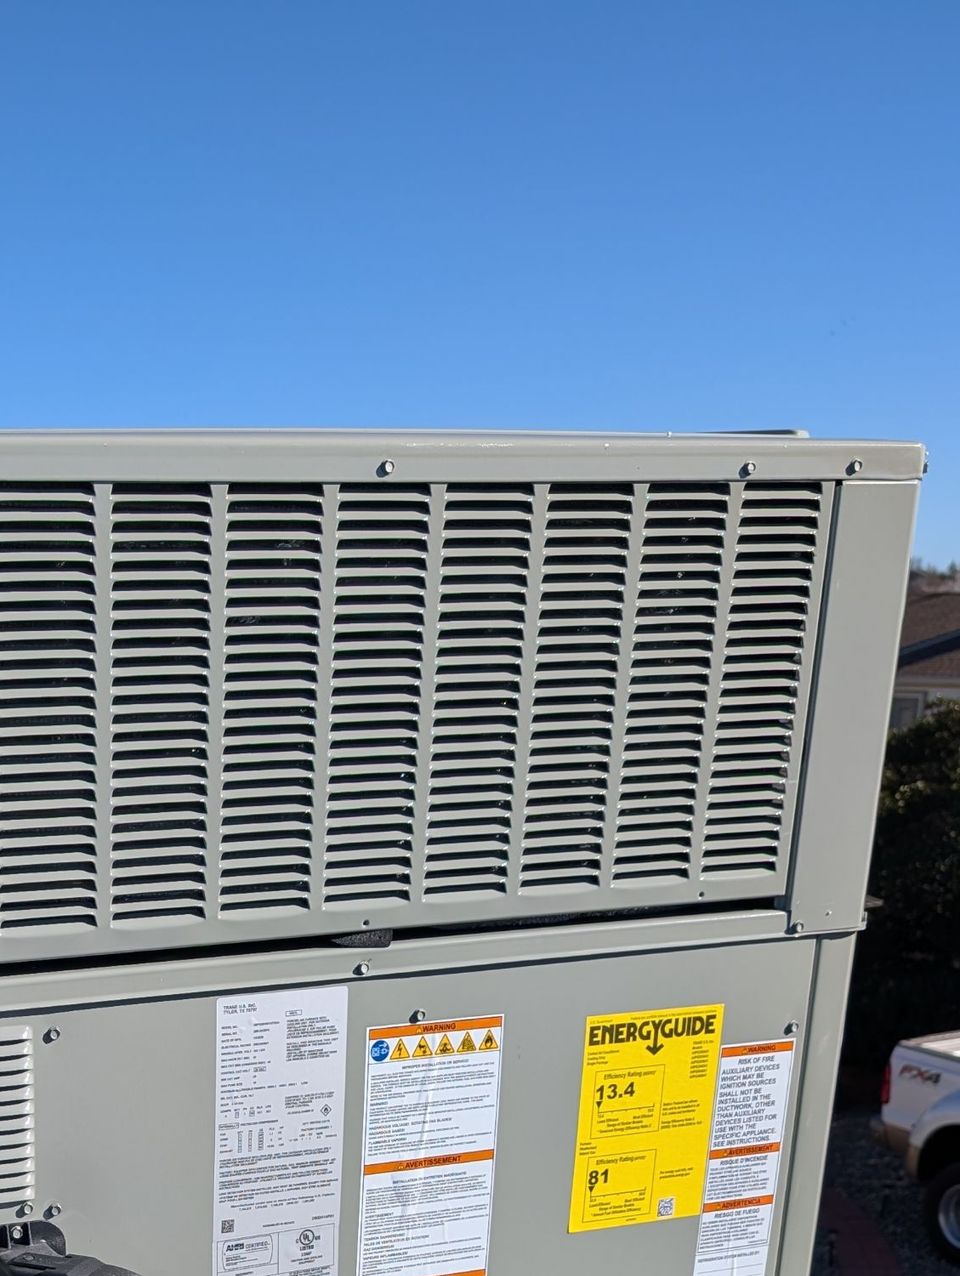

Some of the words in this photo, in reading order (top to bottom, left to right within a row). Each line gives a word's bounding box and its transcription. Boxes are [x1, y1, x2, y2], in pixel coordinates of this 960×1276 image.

[423, 1023, 456, 1032] WARNING
[588, 1014, 717, 1046] ENERGYGUIDE
[722, 1067, 753, 1075] AUXILIARY
[720, 1081, 746, 1089] IGNITION
[748, 1078, 776, 1087] SOURCES
[596, 1082, 635, 1100] 13.4
[720, 1090, 738, 1098] SHALL
[718, 1096, 750, 1104] INSTALLED
[734, 1109, 765, 1117] AUXILIARY
[716, 1118, 741, 1126] DEVICES
[714, 1132, 740, 1140] SPECIFIC
[405, 1156, 461, 1169] AVERTISSEMENT
[588, 1169, 609, 1185] 81
[721, 1199, 761, 1209] ADVERTENCIA
